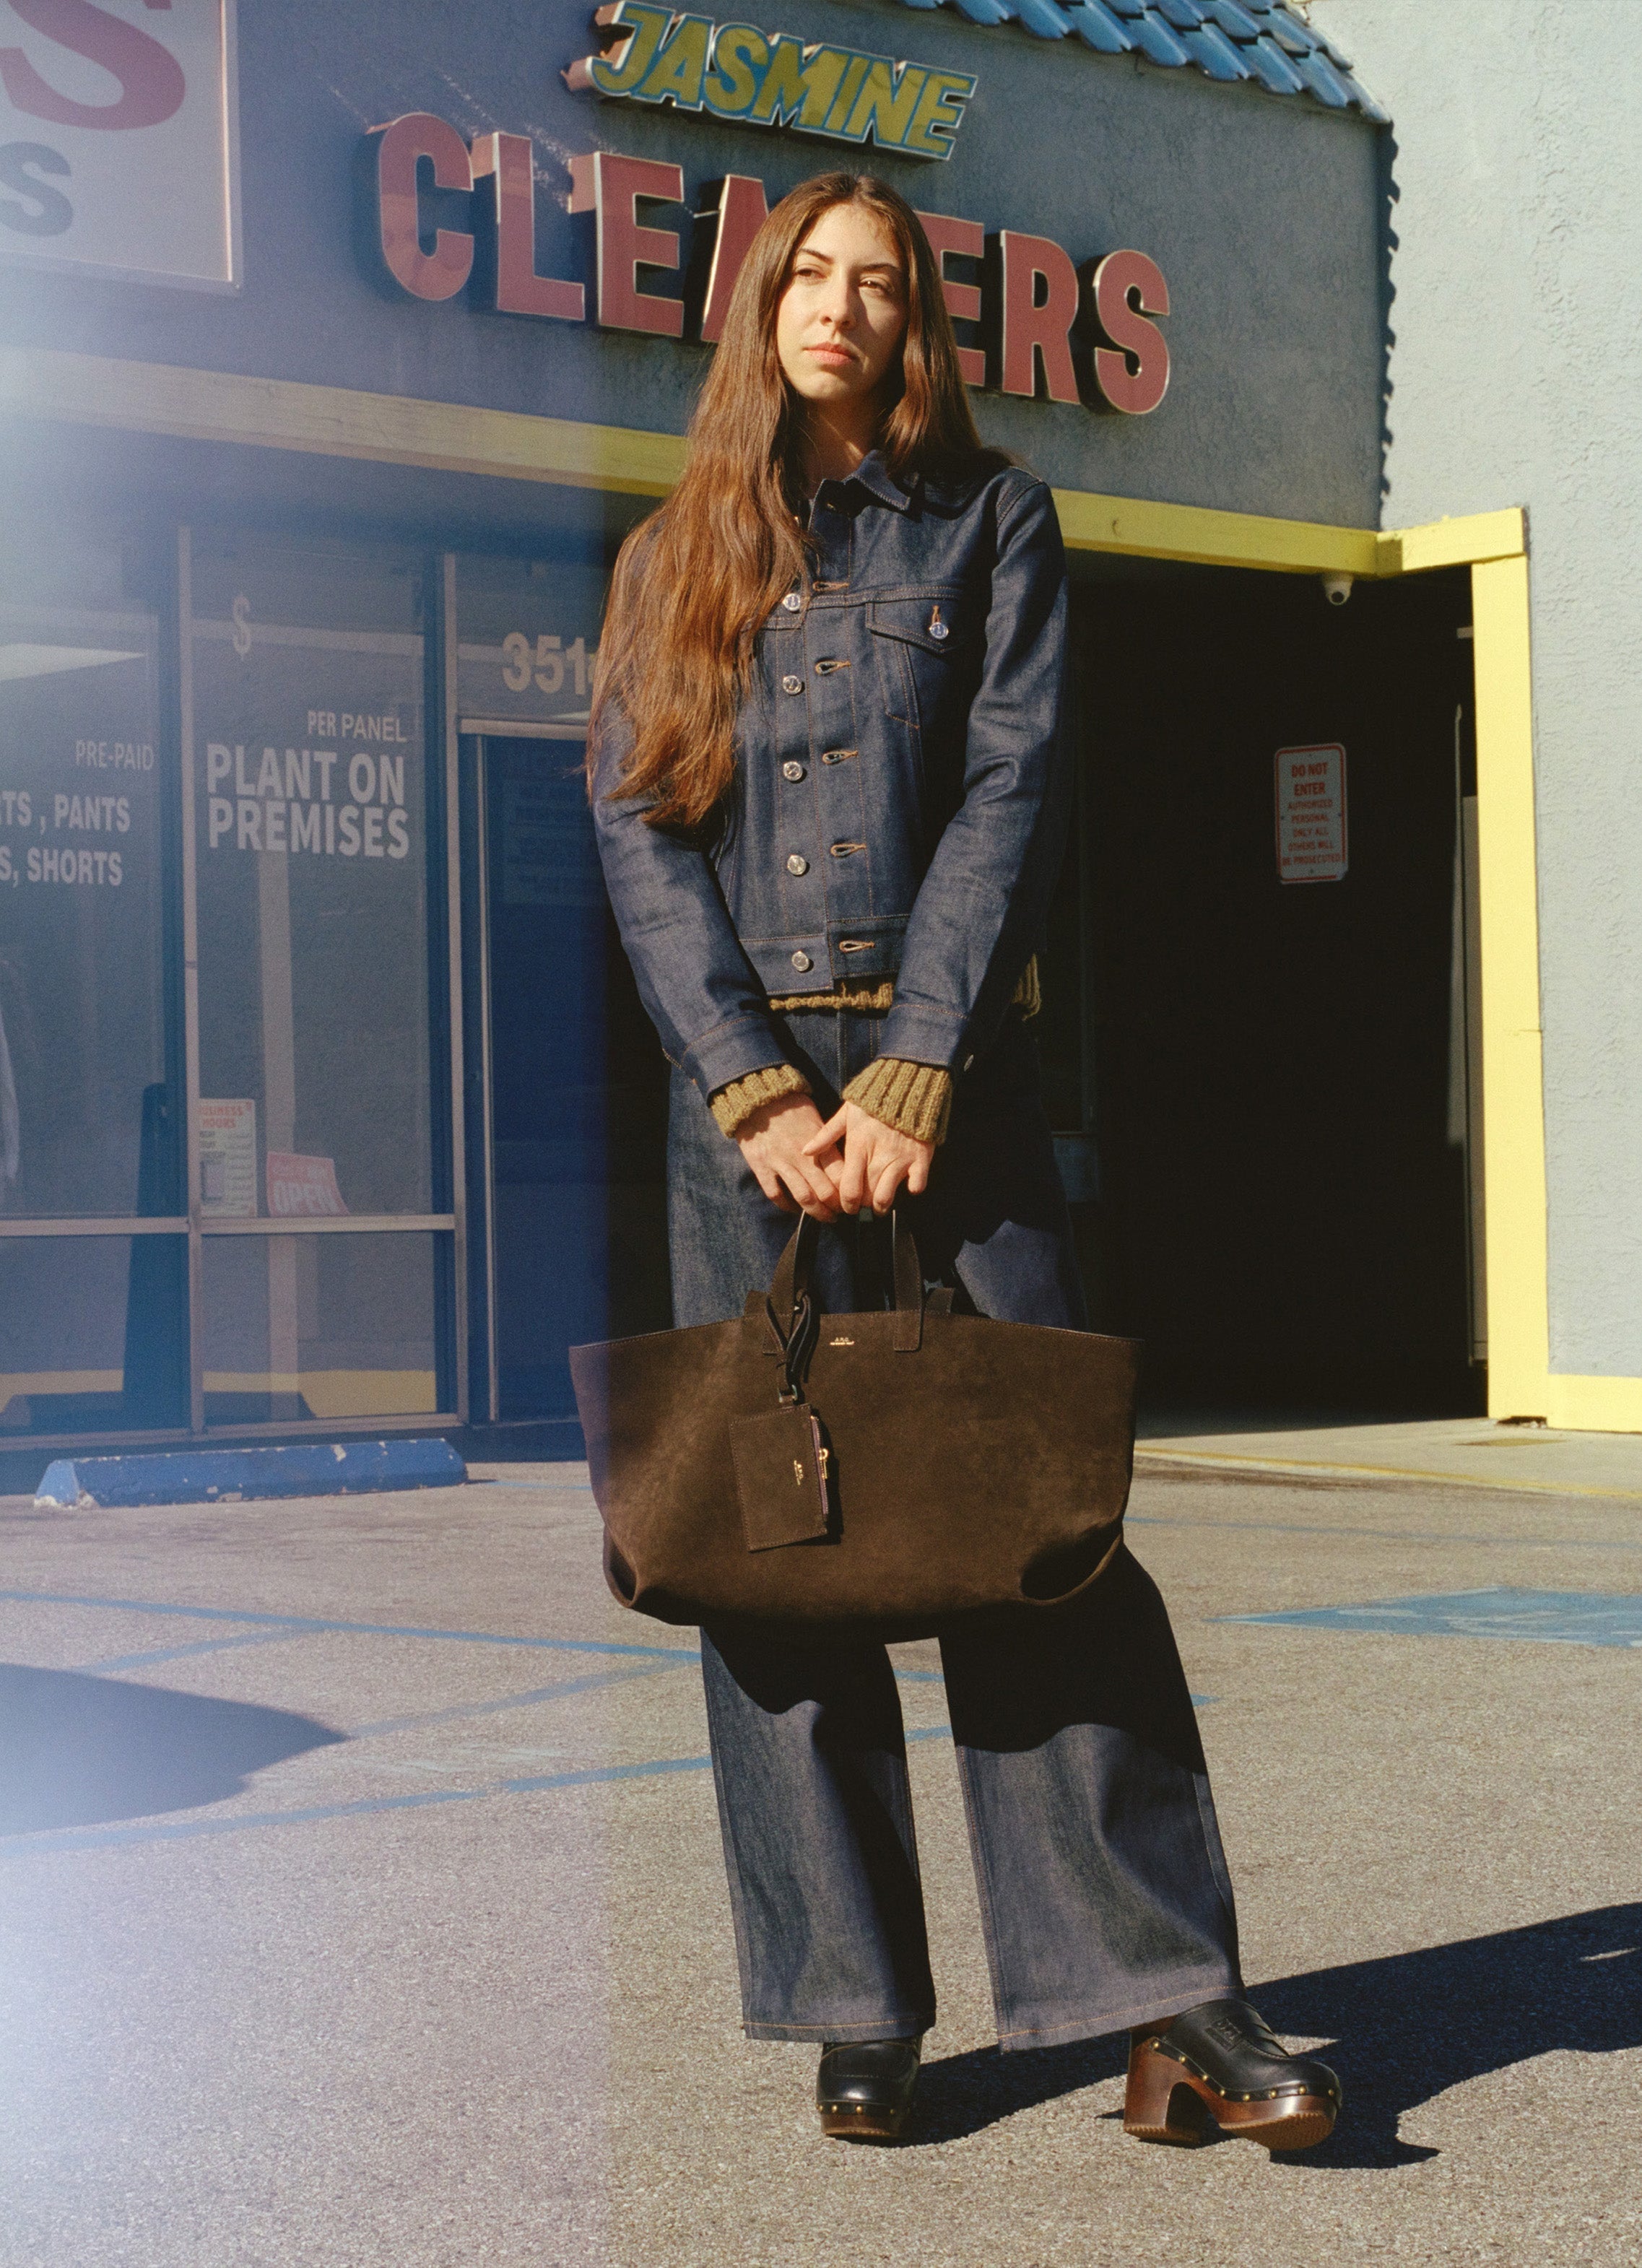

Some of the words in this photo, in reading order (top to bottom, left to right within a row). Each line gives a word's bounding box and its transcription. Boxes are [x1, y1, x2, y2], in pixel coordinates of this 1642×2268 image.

[583, 0, 978, 160] JASMINE
[308, 710, 336, 737] PER
[341, 713, 407, 743] PANEL
[75, 739, 155, 770] PRE-PAID
[1292, 765, 1305, 778] DO
[1308, 763, 1328, 775] NOT
[207, 743, 337, 801] PLANT
[348, 753, 405, 806] ON
[1295, 783, 1325, 796] ENTER
[0, 790, 32, 827] TS
[54, 794, 130, 832] PANTS
[1288, 799, 1332, 810] AUTHORIZED
[209, 796, 409, 859] PREMISES
[27, 846, 123, 887] SHORTS
[274, 1181, 338, 1213] OPEN
